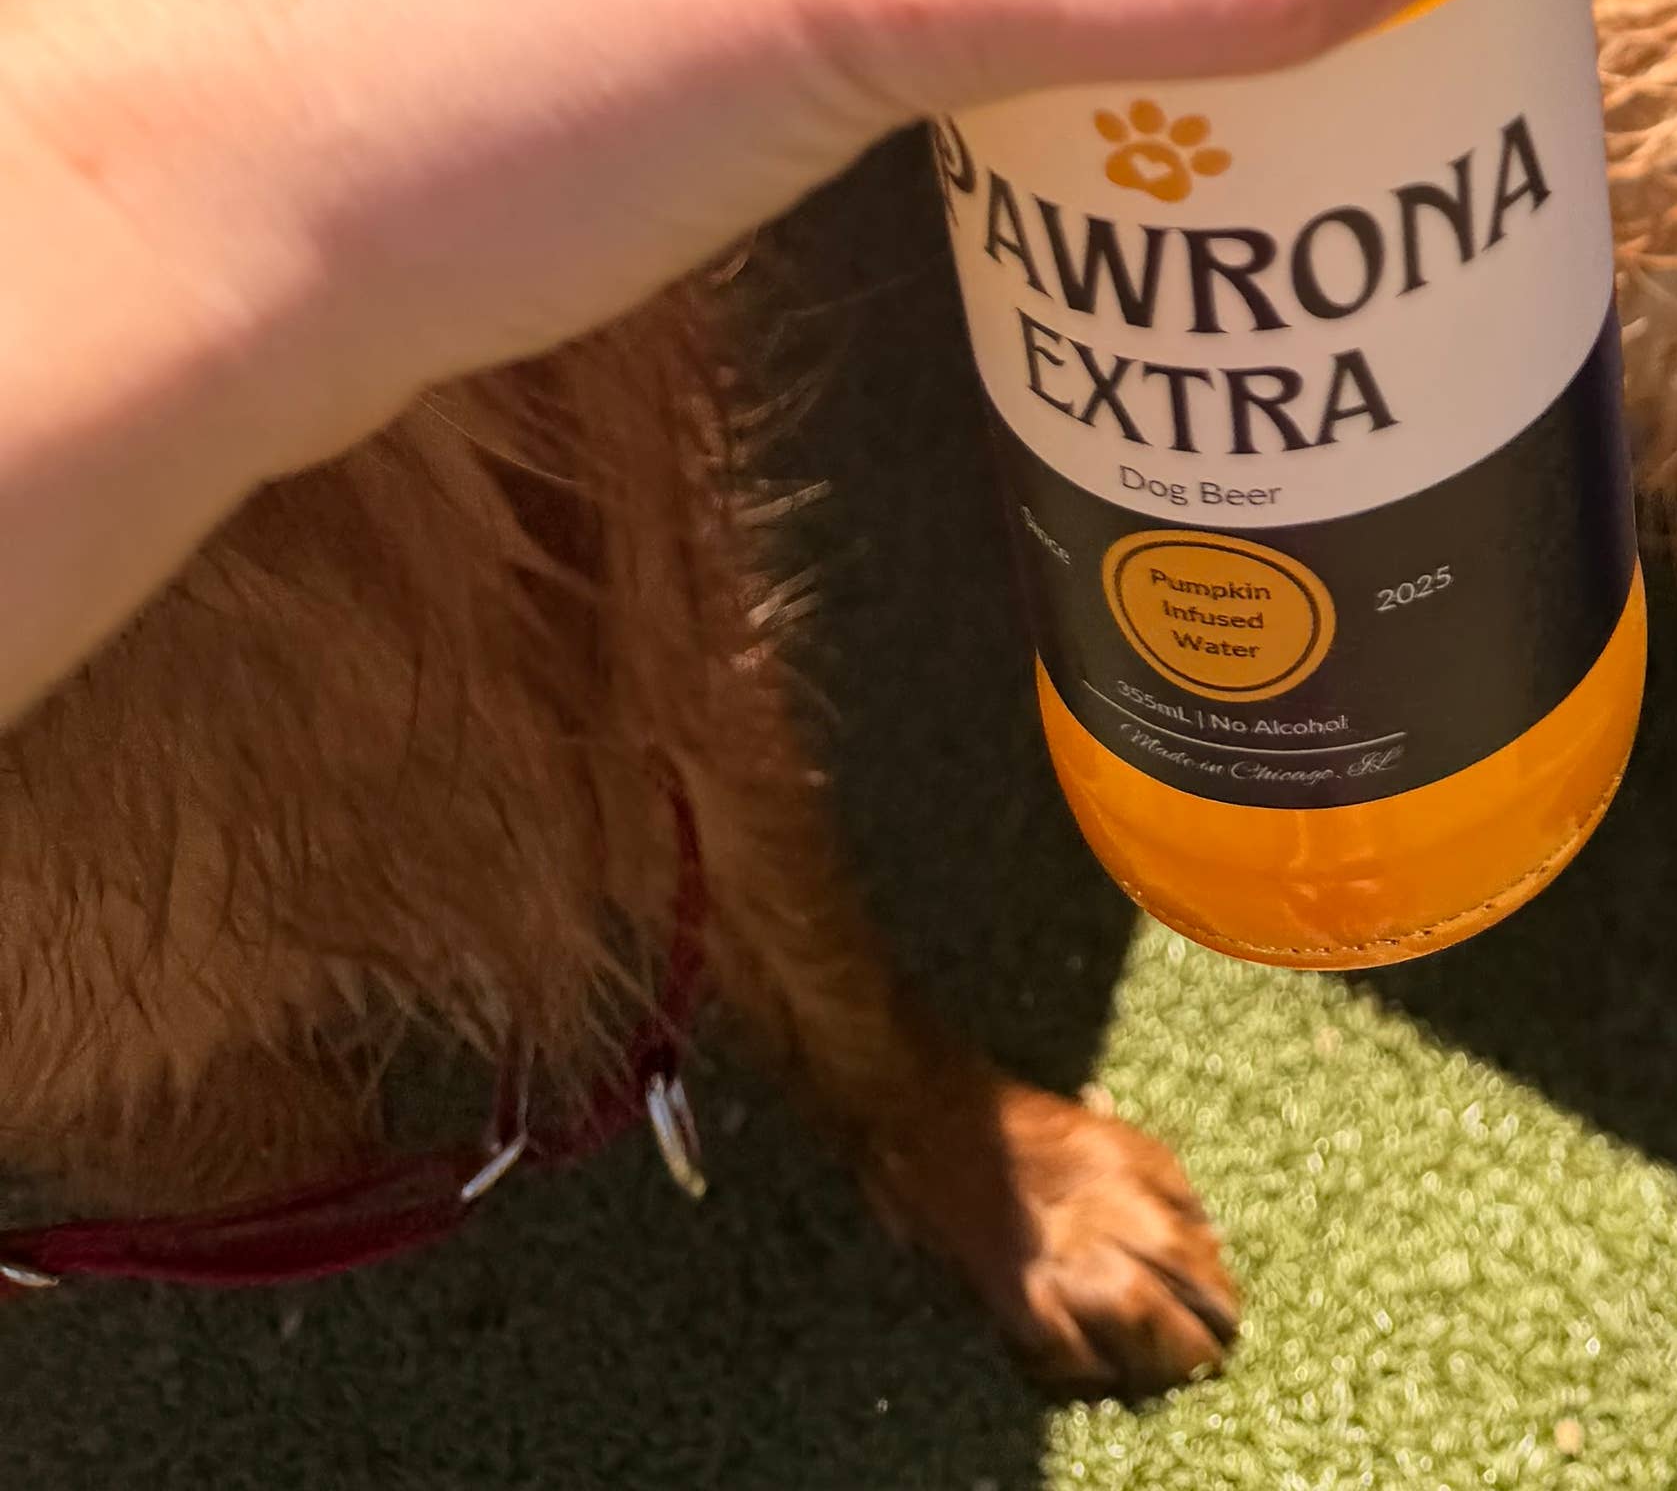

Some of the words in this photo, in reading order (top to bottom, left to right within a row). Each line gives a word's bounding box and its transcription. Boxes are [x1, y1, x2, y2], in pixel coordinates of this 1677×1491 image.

[933, 113, 1553, 336] PAWRONA
[1017, 307, 1402, 456] EXTRA
[1119, 465, 1190, 507] Dog
[1199, 481, 1284, 507] Beer
[1150, 568, 1272, 601] Pumpkin
[1375, 565, 1453, 612] 2025
[1162, 599, 1265, 630] Infused
[1171, 630, 1261, 659] Water
[1116, 679, 1194, 725] 355mL
[1210, 714, 1248, 734] No
[1253, 715, 1350, 736] Alcohol
[1119, 722, 1200, 771] Made
[1199, 759, 1224, 775] in
